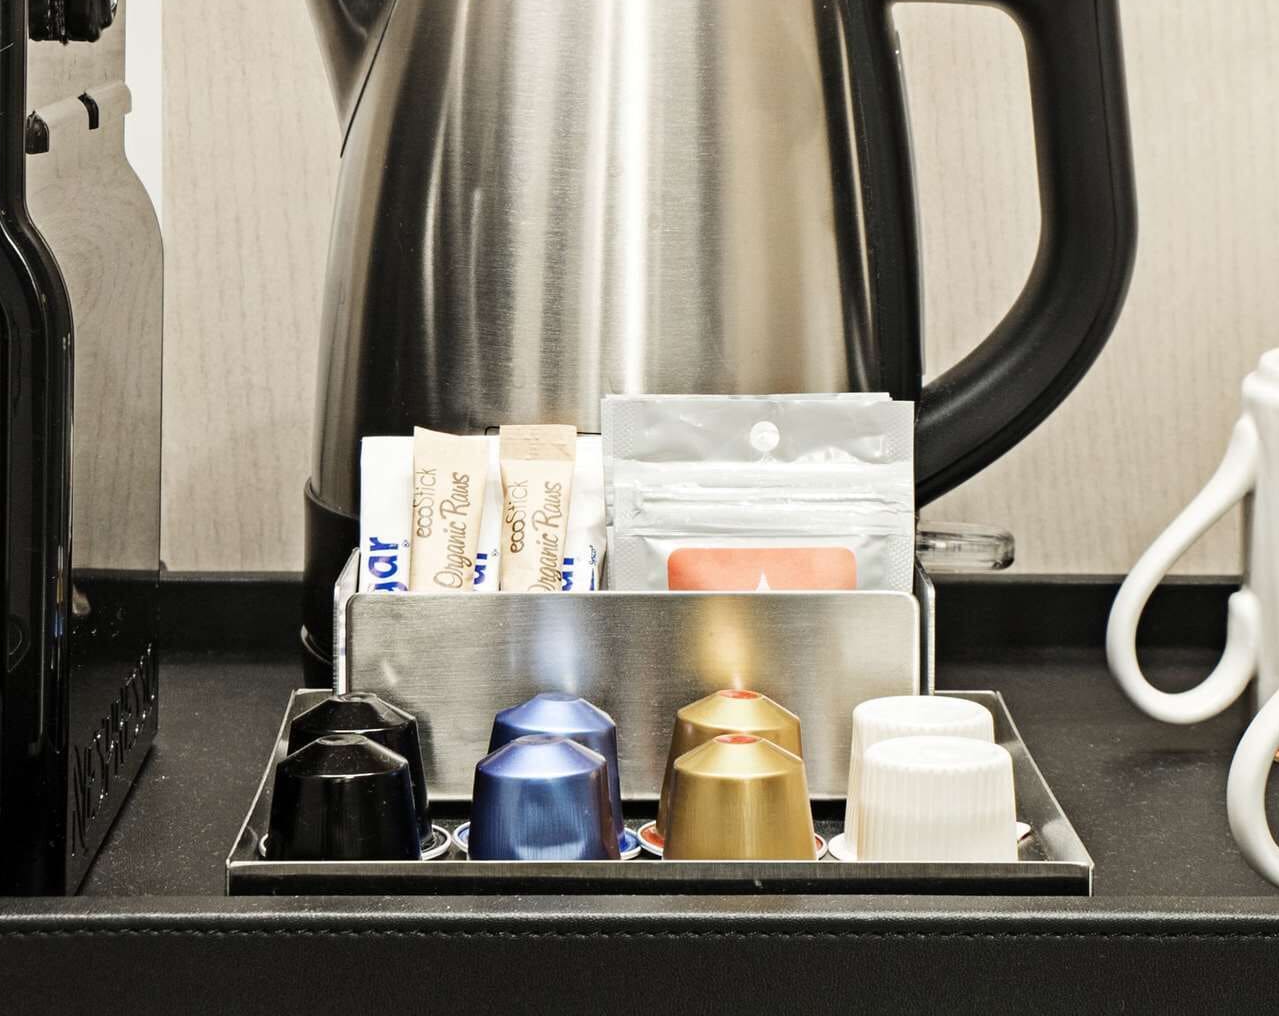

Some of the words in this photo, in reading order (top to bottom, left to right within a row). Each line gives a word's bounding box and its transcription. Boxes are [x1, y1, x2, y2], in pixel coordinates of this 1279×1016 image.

[412, 466, 437, 538] ecoStick
[439, 471, 470, 520] Raws
[505, 479, 529, 554] ecoStick
[531, 481, 563, 532] Raws
[433, 520, 472, 589] Organic
